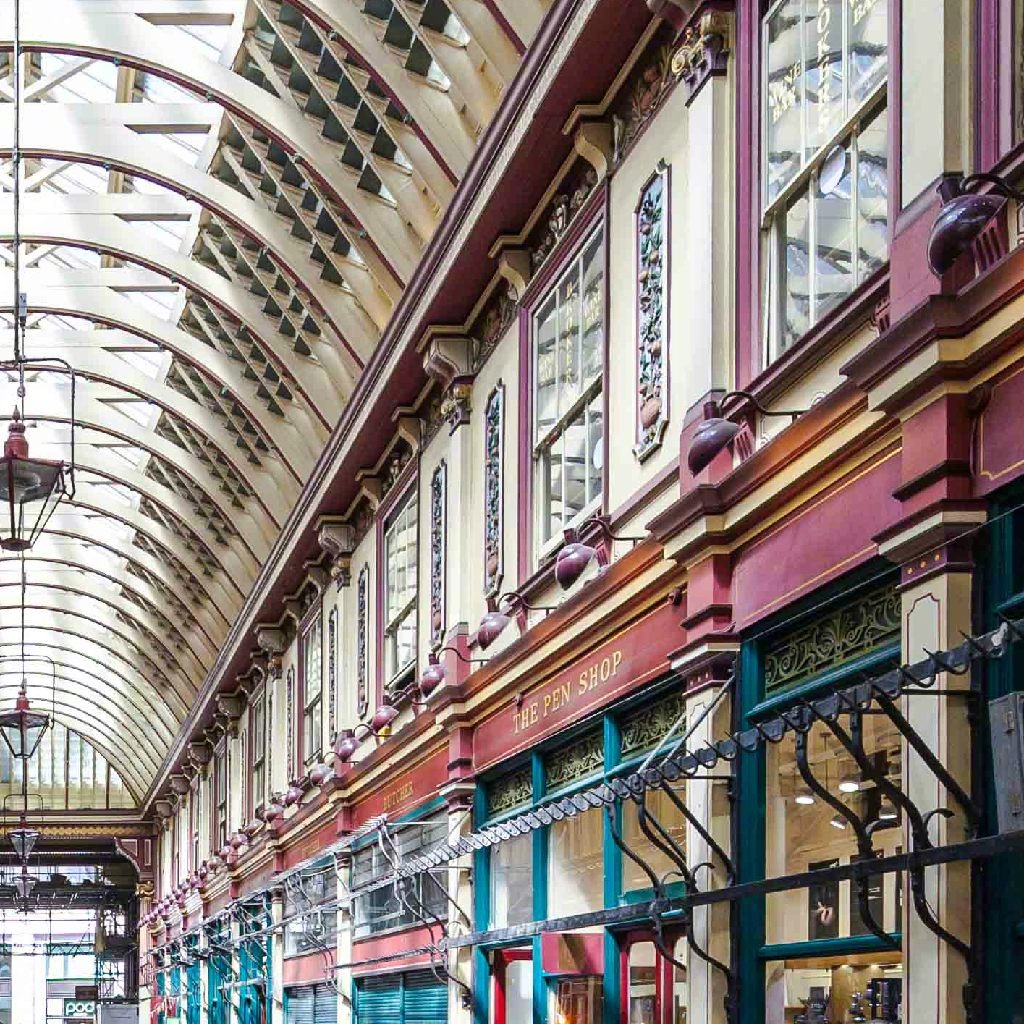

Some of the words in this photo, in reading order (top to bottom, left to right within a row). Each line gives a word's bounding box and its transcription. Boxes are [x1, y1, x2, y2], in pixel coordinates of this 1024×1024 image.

[513, 702, 539, 734] THE
[542, 681, 572, 717] PEN
[578, 650, 622, 696] SHOP
[382, 780, 414, 812] BUTCHER
